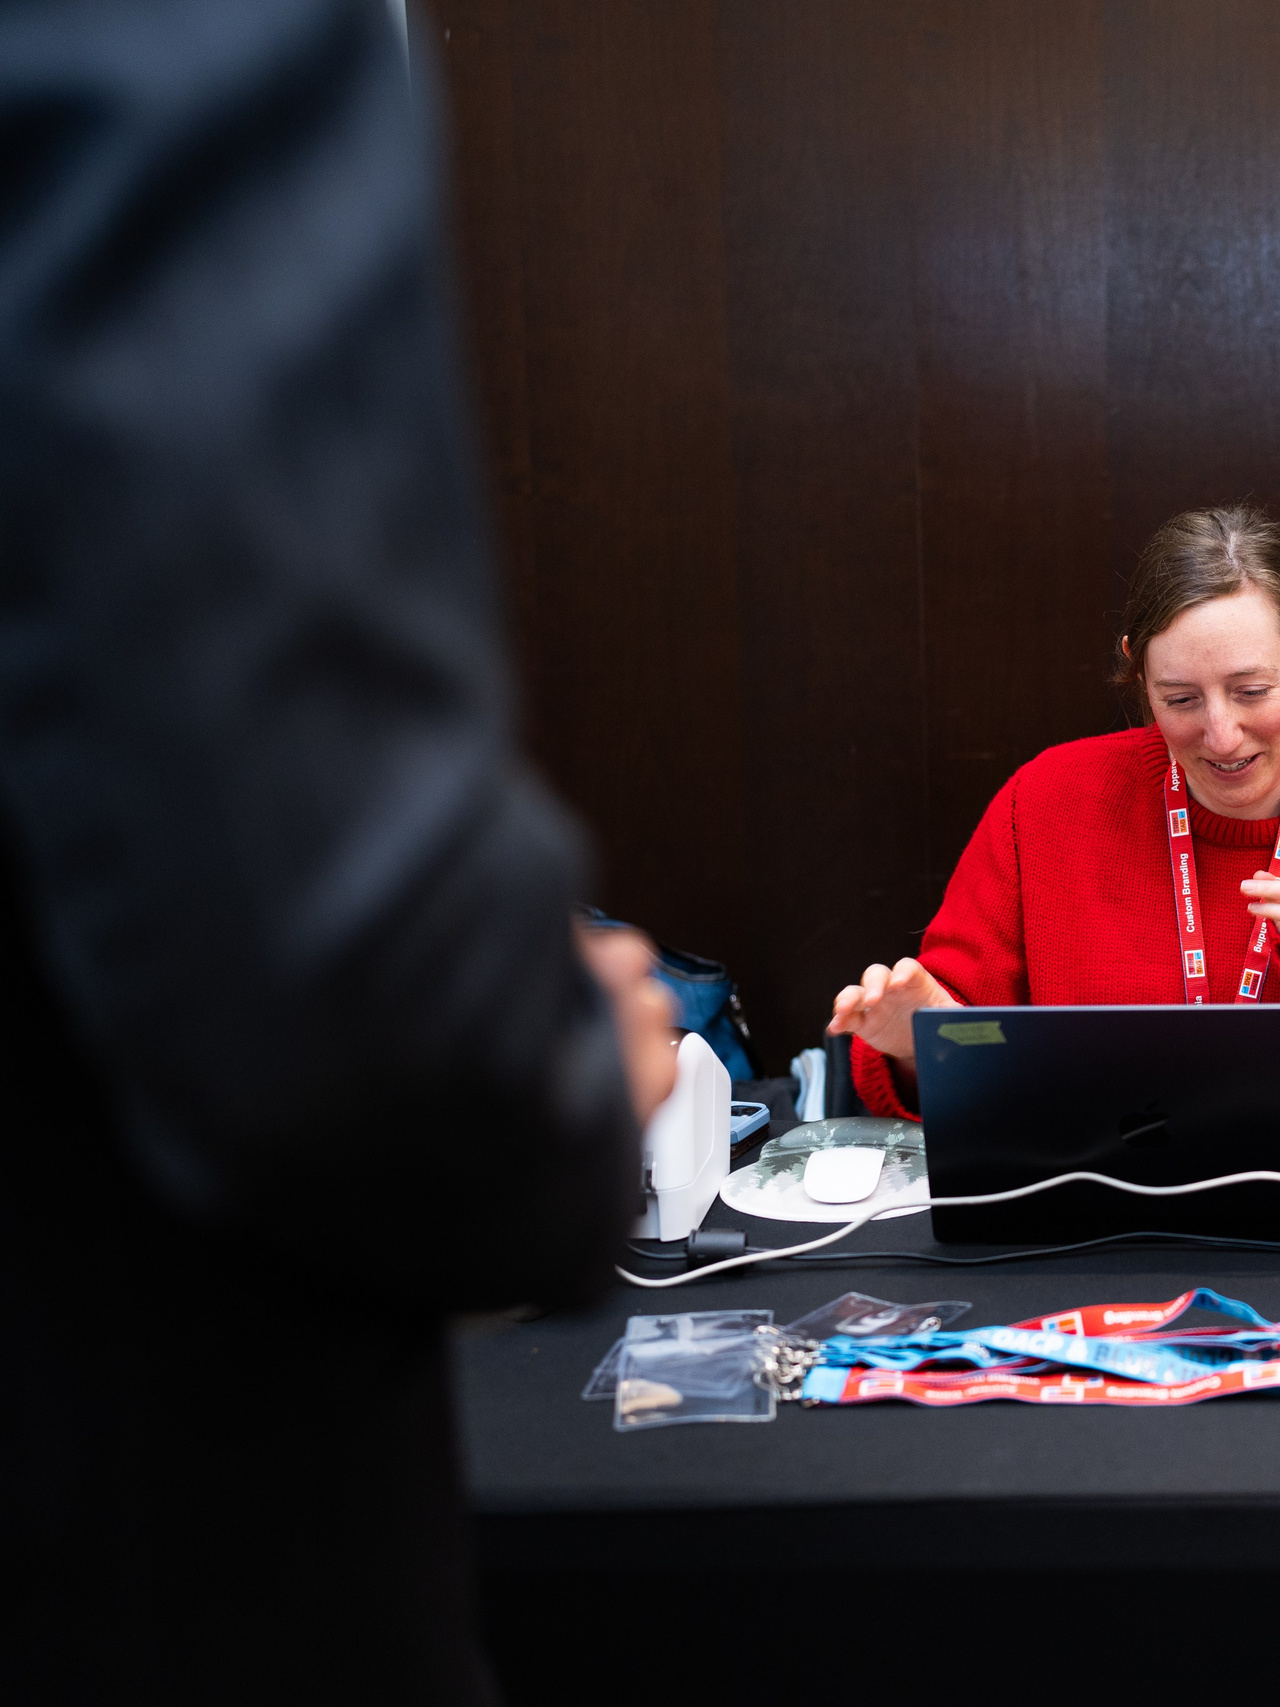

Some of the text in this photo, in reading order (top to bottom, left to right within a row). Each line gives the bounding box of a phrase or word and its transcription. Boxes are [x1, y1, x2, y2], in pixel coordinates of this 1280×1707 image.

[1180, 853, 1196, 933] Custom Branding
[1253, 917, 1267, 953] anding
